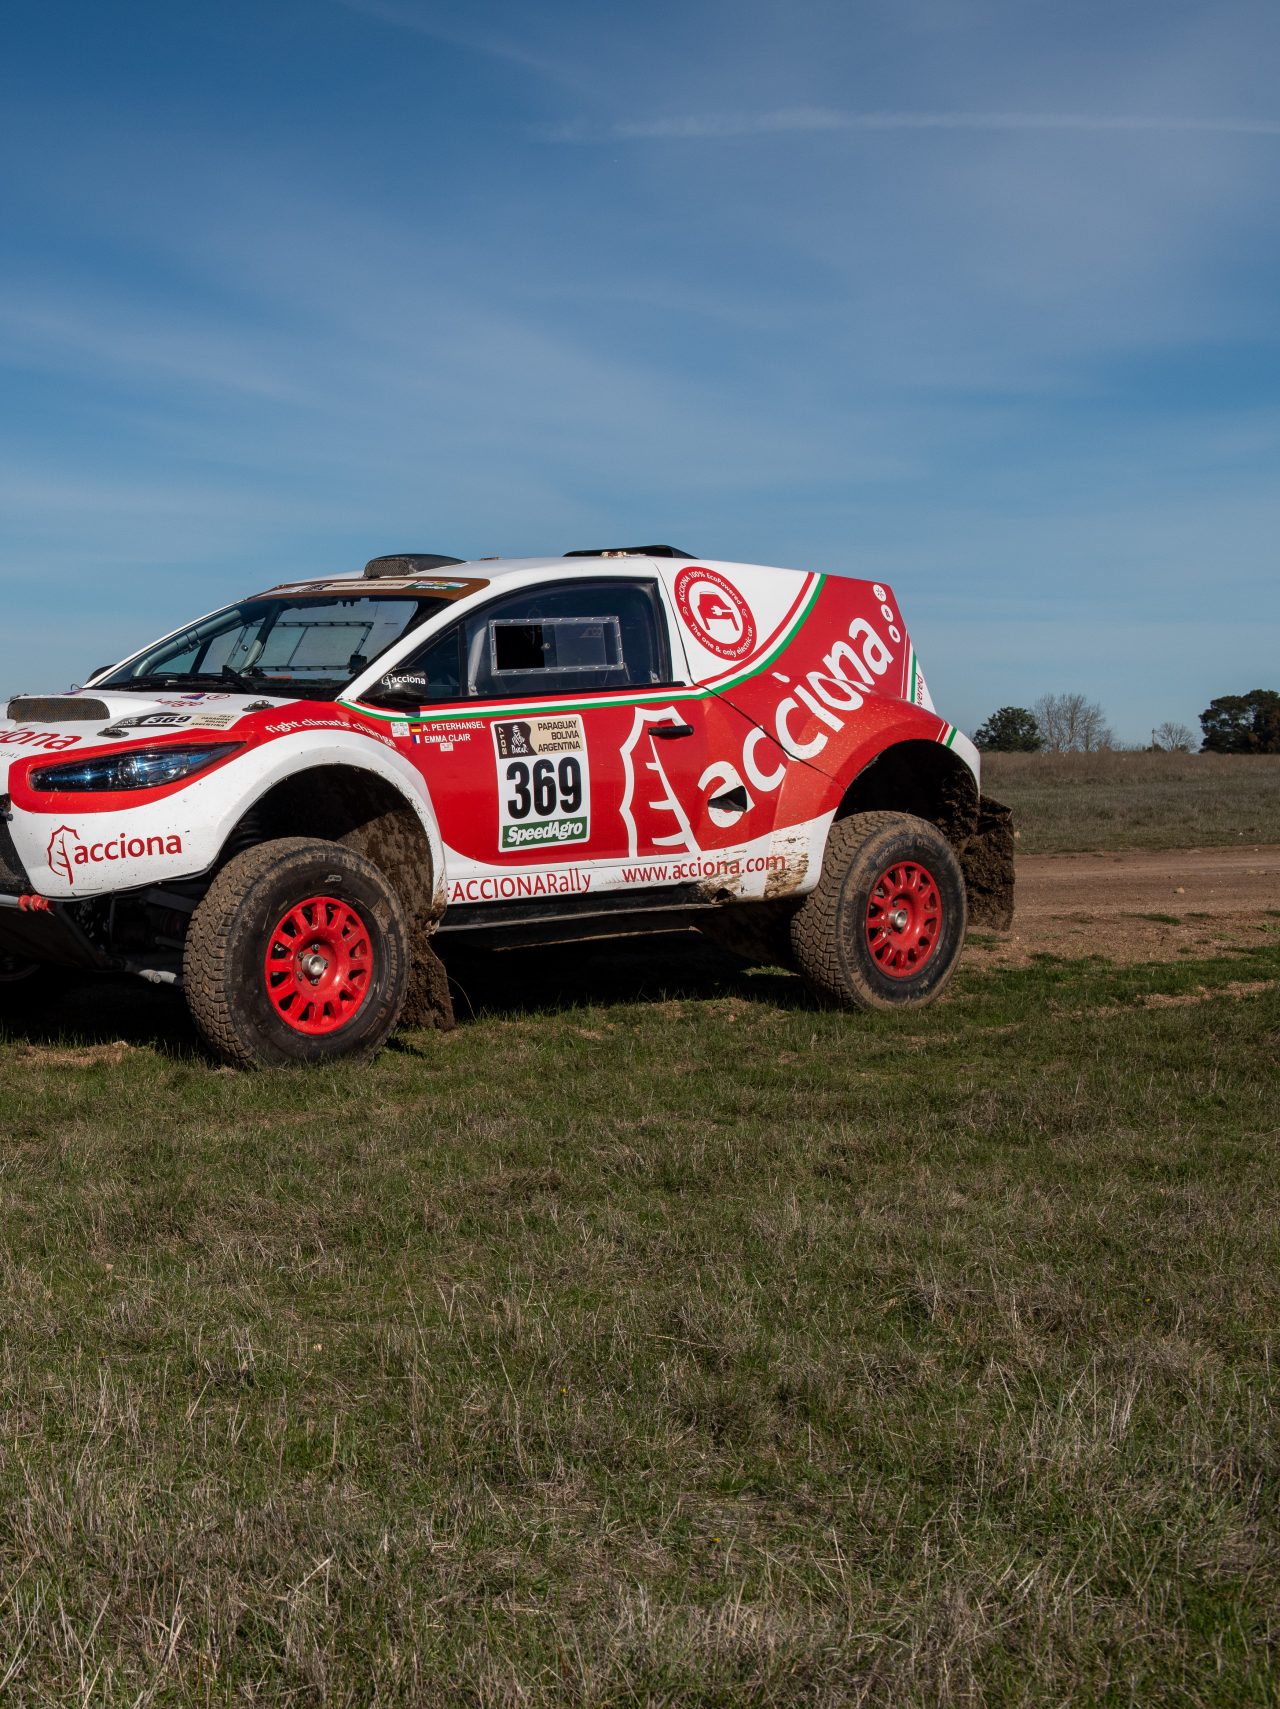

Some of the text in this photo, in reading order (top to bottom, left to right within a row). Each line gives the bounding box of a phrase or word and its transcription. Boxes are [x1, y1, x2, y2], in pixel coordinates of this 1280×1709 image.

[678, 571, 743, 605] ACCIONA 100% EcoPowered
[690, 622, 702, 637] The
[701, 637, 714, 649] one
[722, 649, 736, 658] only
[736, 636, 752, 655] electric
[391, 674, 426, 685] acciona
[146, 715, 193, 725] 369
[265, 720, 303, 734] fight
[301, 718, 351, 729] climate
[352, 722, 397, 748] change
[422, 723, 431, 732] A.
[431, 721, 486, 732] PETERHANSEL
[538, 720, 577, 731] PARAGUAY
[697, 617, 895, 829] acciona
[424, 733, 471, 744] EMMA CLAIR
[497, 726, 508, 755] 2017
[538, 740, 581, 753] ARGENTINA
[551, 730, 580, 741] BOLIVIA
[506, 756, 582, 820] 369
[507, 821, 583, 845] SpeedAgro
[73, 832, 183, 866] acciona
[622, 855, 786, 883] www.acciona.com
